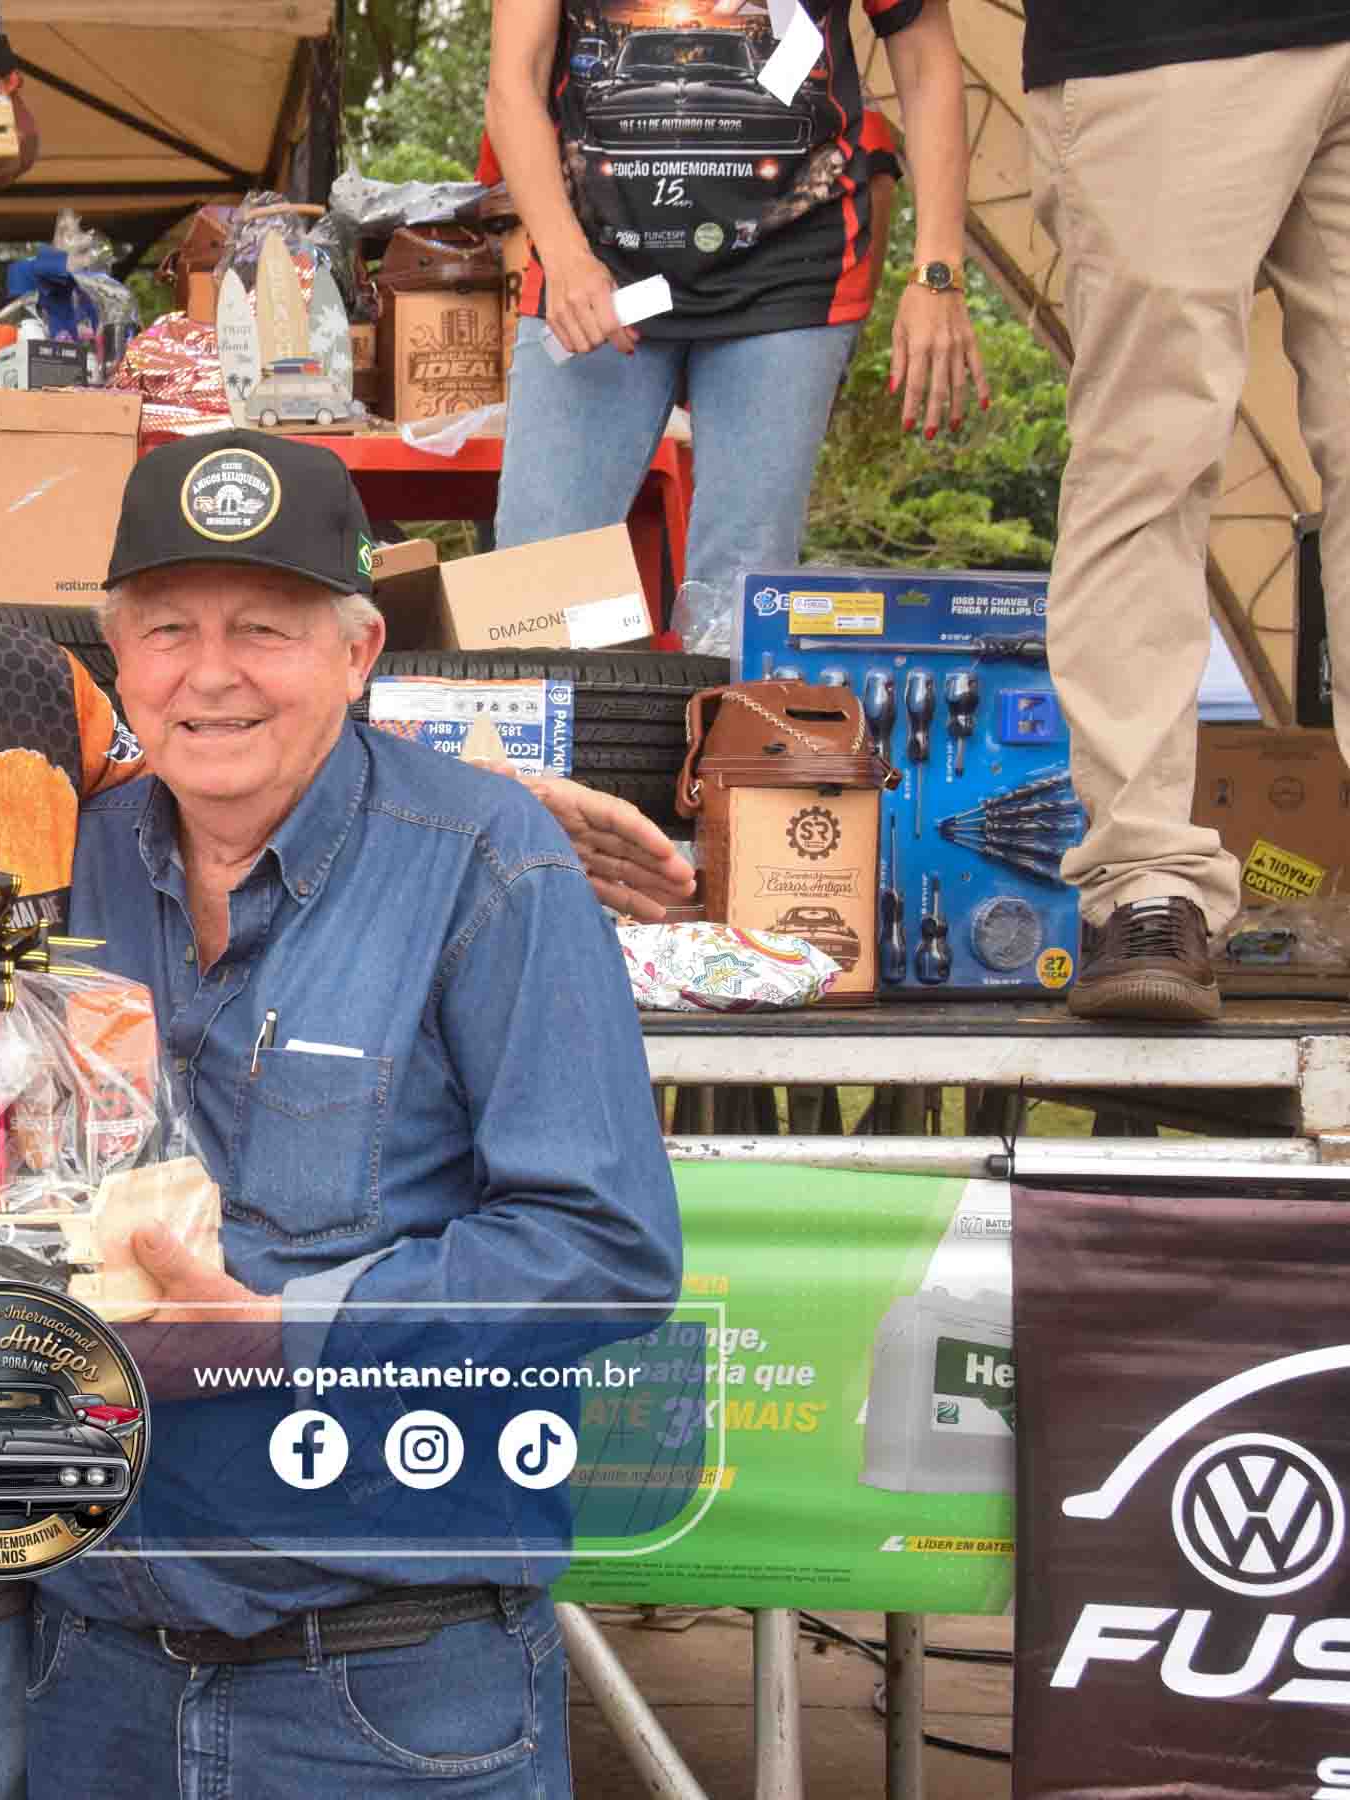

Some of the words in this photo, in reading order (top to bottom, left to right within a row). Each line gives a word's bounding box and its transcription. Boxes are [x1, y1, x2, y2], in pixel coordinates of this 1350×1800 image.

[614, 160, 649, 178] EDIÇÃO
[652, 161, 753, 177] COMEMORATIVA
[652, 177, 685, 206] 15
[414, 361, 499, 378] IDEAL
[553, 709, 567, 777] PALLYKIN
[753, 1362, 816, 1392] que
[1050, 1603, 1350, 1706] FUS
